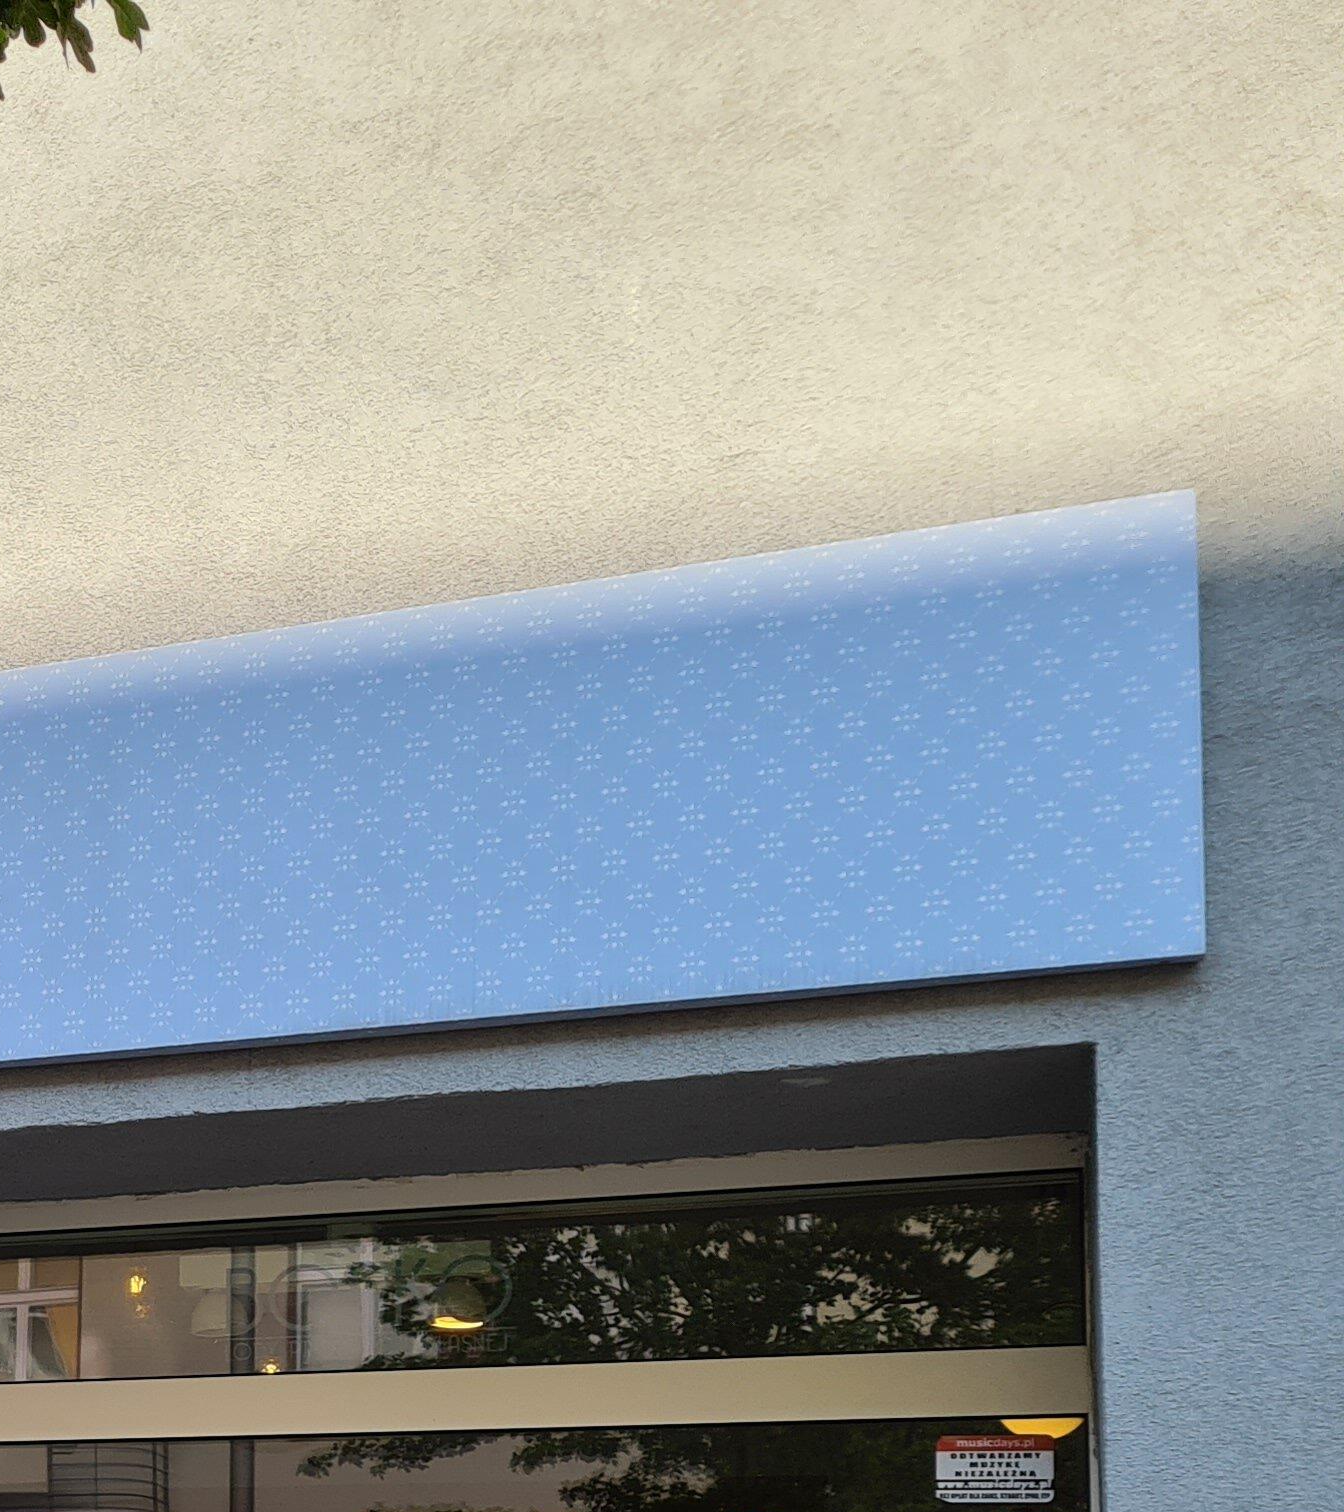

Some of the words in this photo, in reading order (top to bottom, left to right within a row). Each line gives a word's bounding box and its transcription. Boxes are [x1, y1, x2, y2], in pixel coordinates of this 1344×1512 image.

[955, 1437, 1035, 1449] musicdays.pl
[950, 1452, 1042, 1460] ODTWARZAMY
[969, 1461, 1021, 1469] MUZYKĘ
